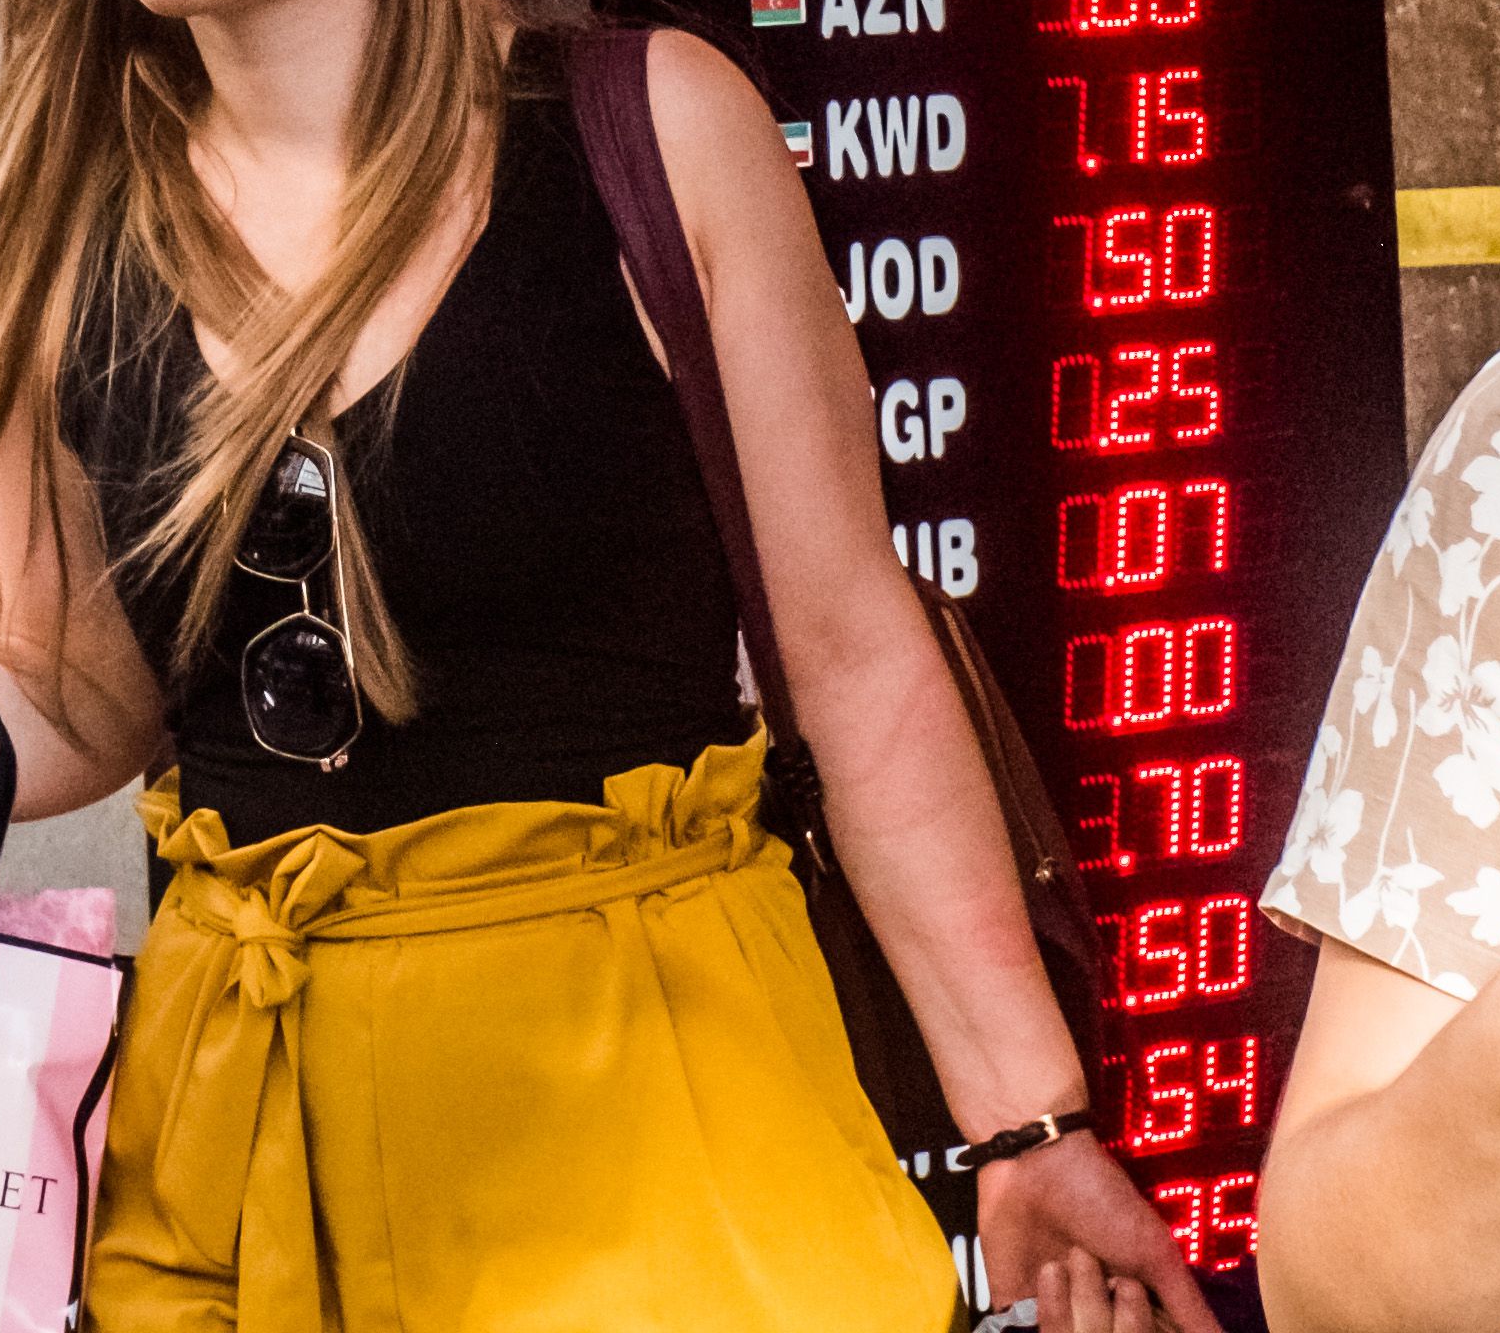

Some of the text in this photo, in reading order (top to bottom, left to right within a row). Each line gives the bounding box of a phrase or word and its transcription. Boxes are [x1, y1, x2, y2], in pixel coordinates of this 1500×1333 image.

[826, 94, 967, 181] KWD
[842, 236, 960, 324] JOD
[872, 378, 966, 464] GP
[893, 518, 979, 599] UB
